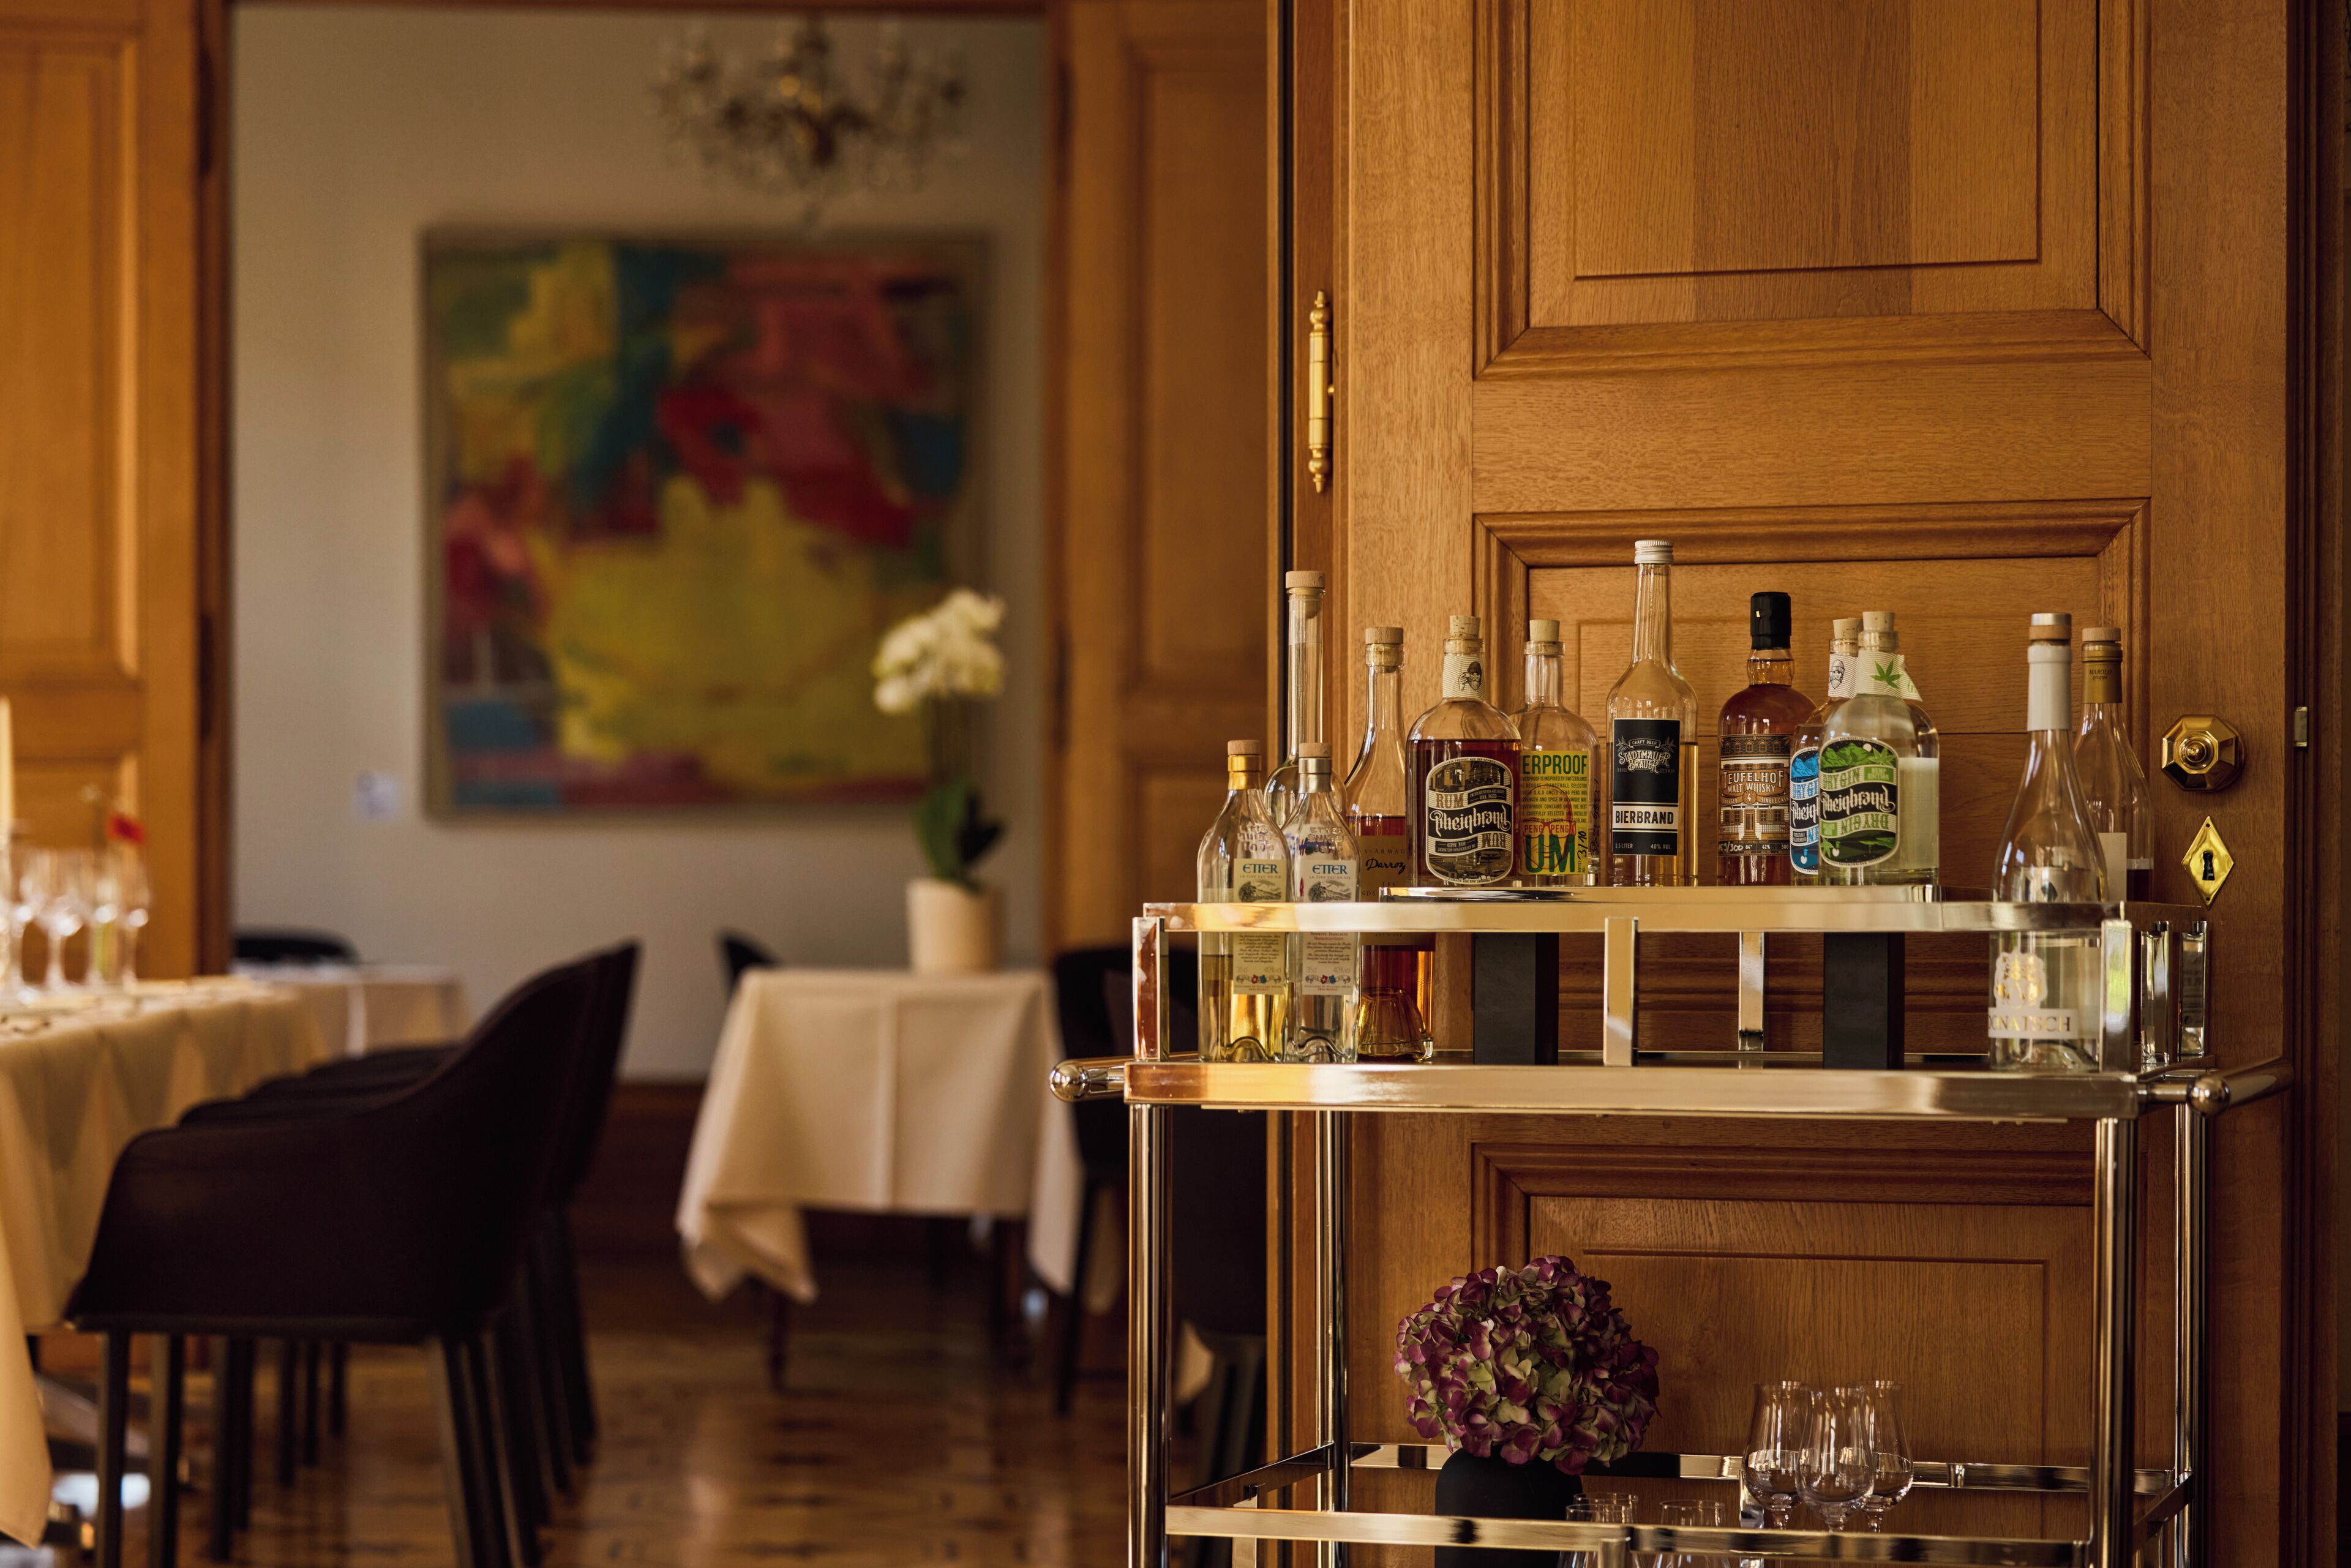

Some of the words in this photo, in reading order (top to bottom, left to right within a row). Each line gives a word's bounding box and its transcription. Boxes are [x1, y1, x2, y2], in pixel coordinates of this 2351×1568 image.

[1522, 754, 1587, 775] ERPROOF
[1628, 759, 1659, 773] BRAUER
[1723, 770, 1783, 789] TEUFELHOF
[1840, 768, 1860, 788] GIN
[1728, 784, 1742, 793] MALT
[1745, 783, 1775, 792] WHISKY
[1807, 781, 1817, 797] GI
[1436, 793, 1465, 808] RUM
[1615, 811, 1674, 824] BIERBRAND
[1841, 815, 1862, 835] GIN
[1864, 814, 1889, 830] DRY
[1524, 825, 1543, 833] PENG
[1551, 825, 1569, 833] PENG
[1525, 835, 1575, 873] UM
[1243, 863, 1278, 874] ETTER
[1312, 864, 1348, 875] ETTER
[1365, 857, 1406, 875] Darroz
